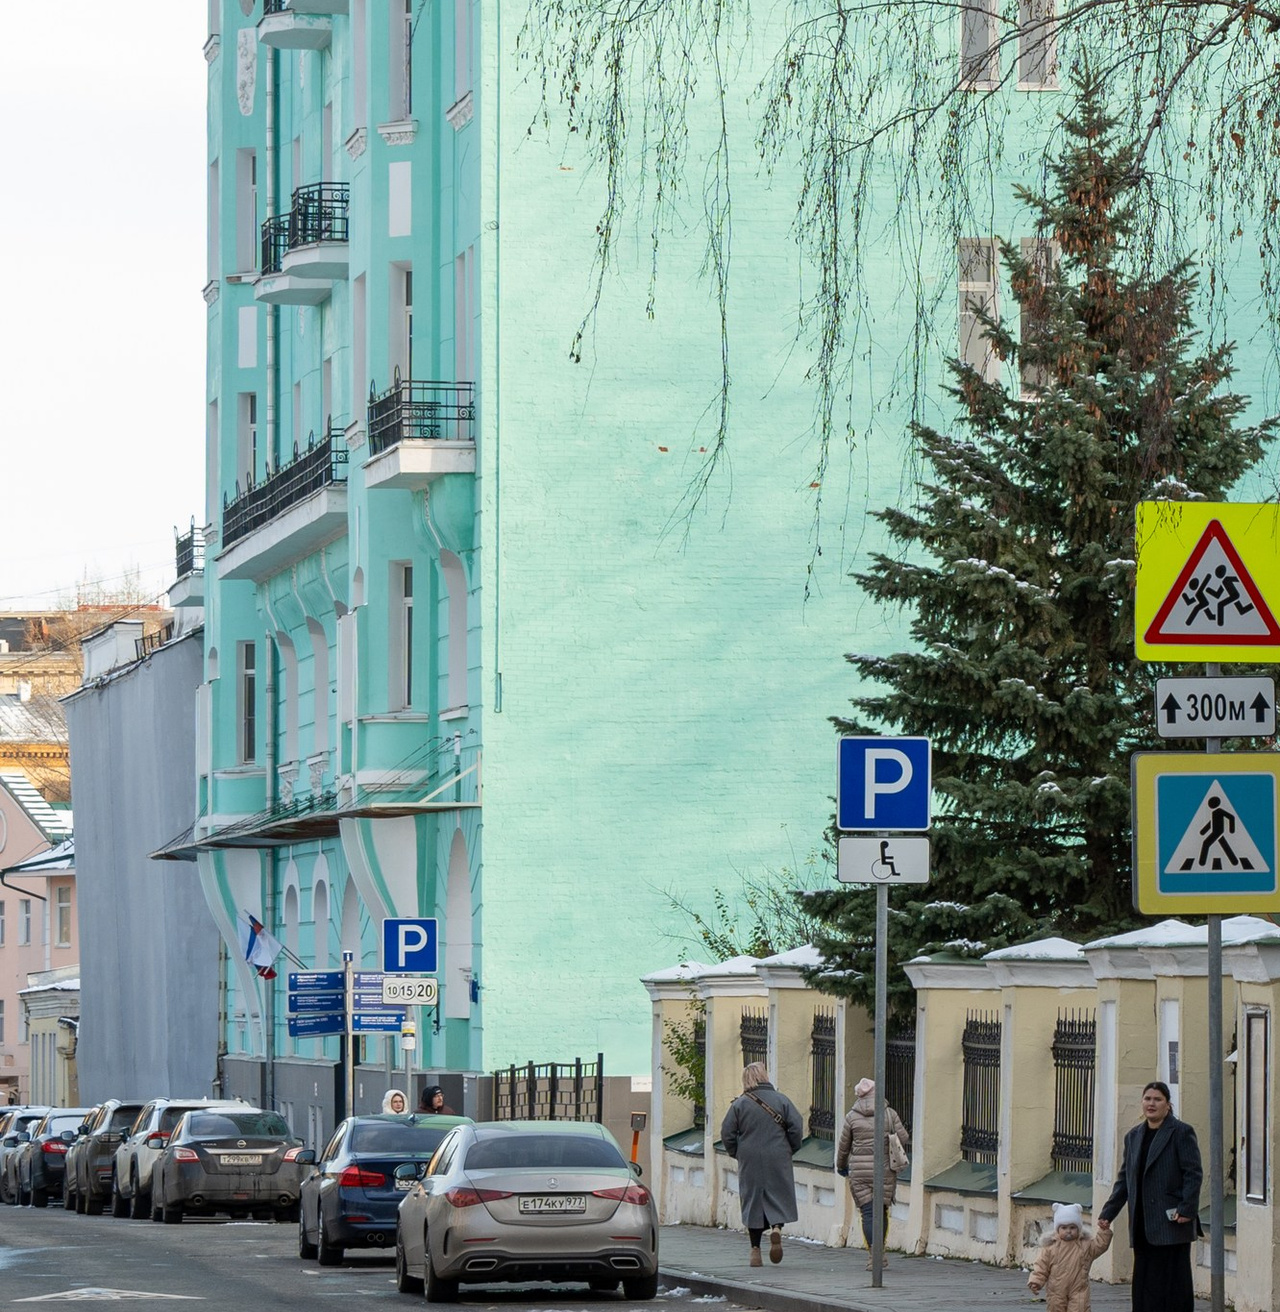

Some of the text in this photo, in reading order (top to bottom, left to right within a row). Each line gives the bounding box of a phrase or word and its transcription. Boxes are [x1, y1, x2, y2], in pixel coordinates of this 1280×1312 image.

[864, 748, 913, 819] P
[398, 924, 428, 967] P
[388, 984, 433, 997] 10 15 20
[566, 1196, 583, 1205] 977
